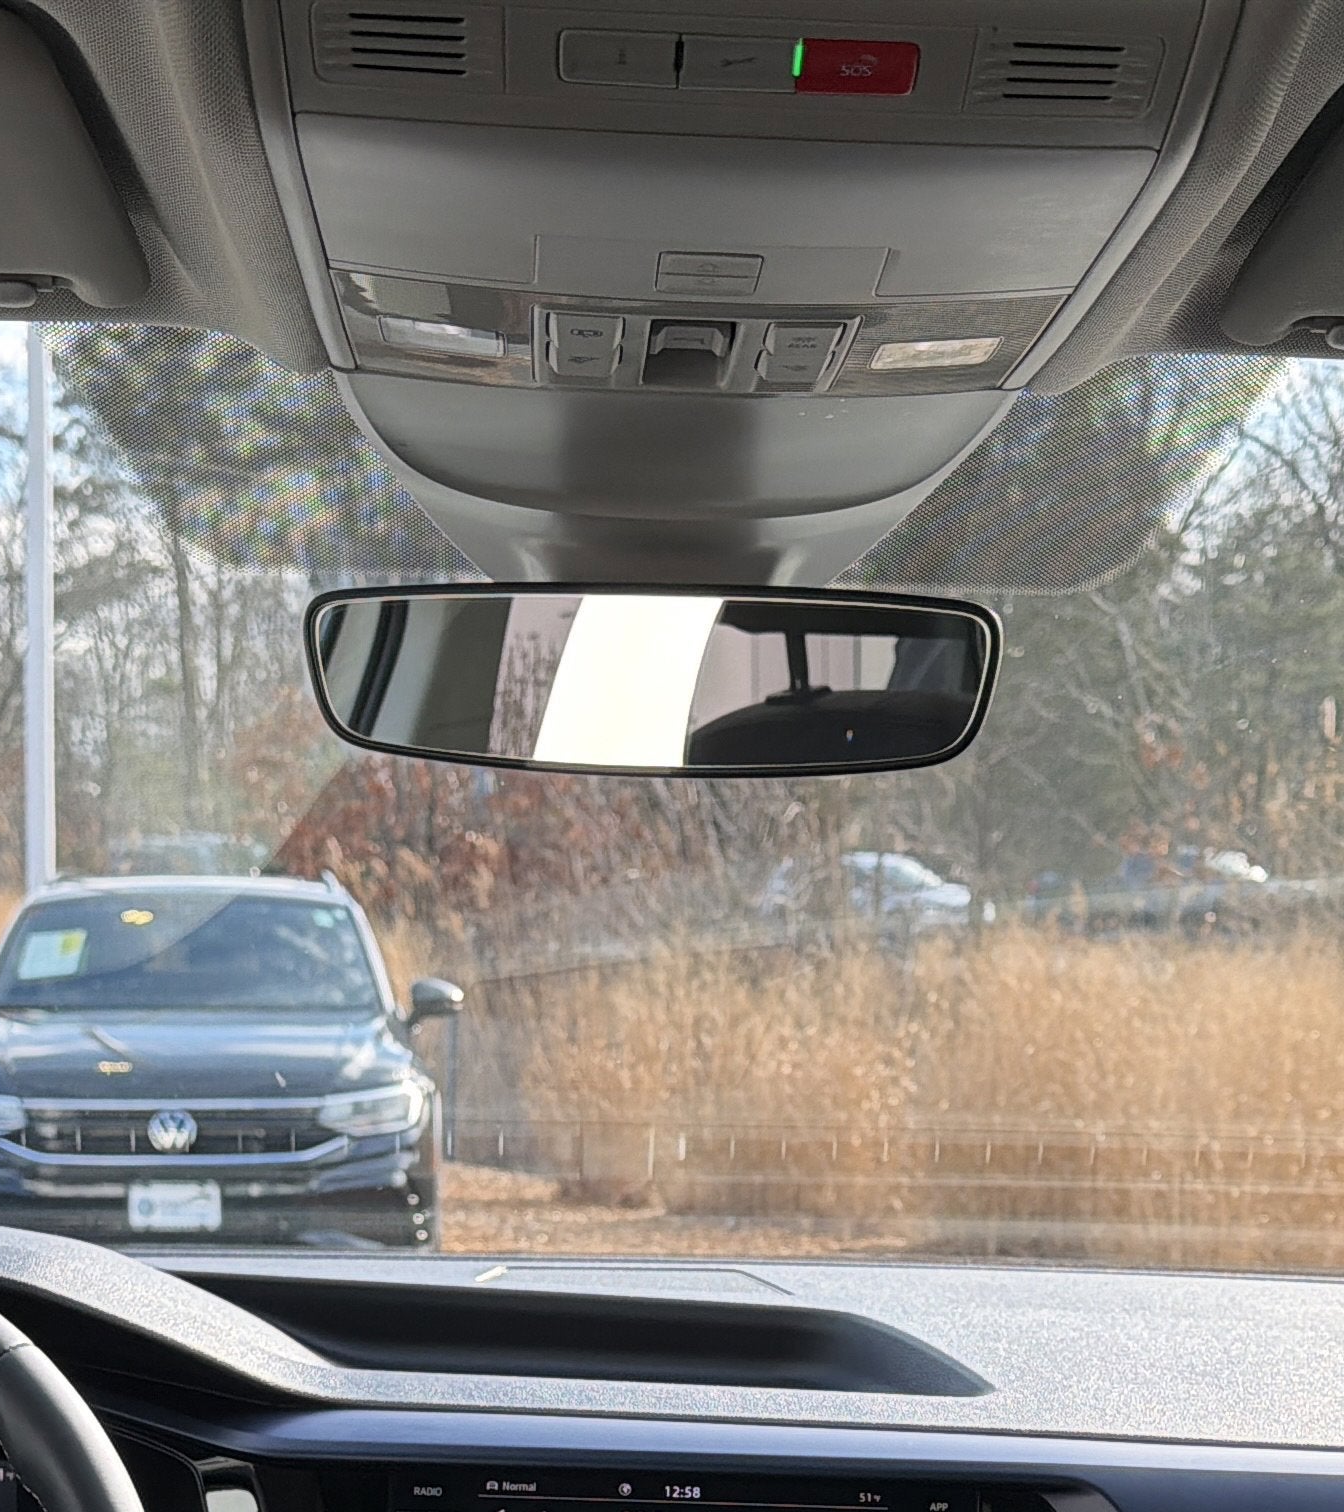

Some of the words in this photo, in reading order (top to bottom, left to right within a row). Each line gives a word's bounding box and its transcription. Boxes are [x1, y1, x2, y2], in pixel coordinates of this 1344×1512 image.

[840, 64, 874, 78] SOS
[413, 1486, 443, 1497] RADIO
[501, 1479, 537, 1493] Normal
[664, 1485, 702, 1500] 12:58
[929, 1501, 950, 1512] APP
